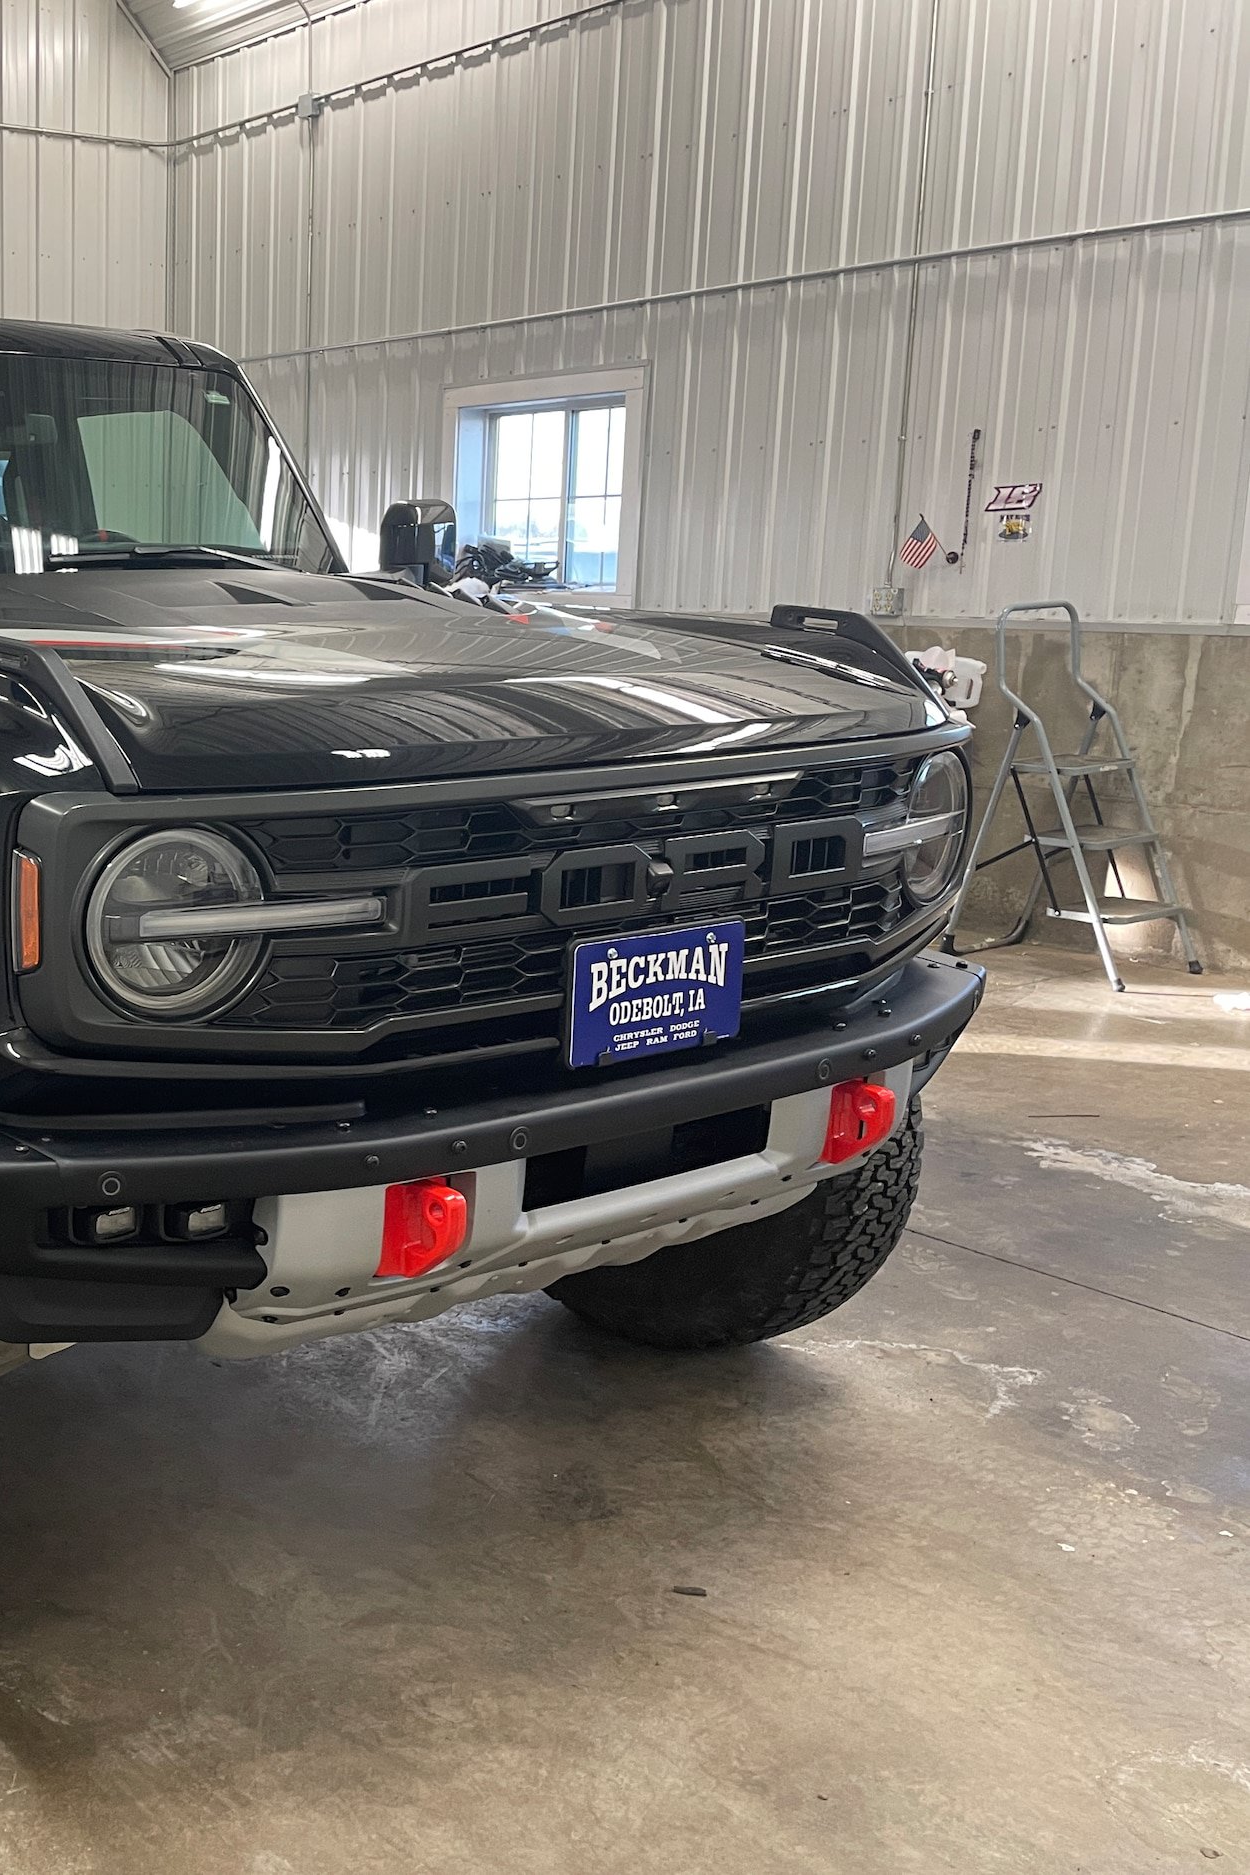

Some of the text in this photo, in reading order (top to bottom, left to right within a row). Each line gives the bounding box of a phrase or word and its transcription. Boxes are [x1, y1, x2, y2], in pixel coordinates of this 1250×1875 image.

[402, 815, 863, 944] FORD
[589, 942, 729, 1012] BECKMAN
[609, 987, 706, 1026] ODEBOLT, IA
[613, 1019, 701, 1043] CHRYSLER DODGE
[615, 1030, 698, 1052] JEEP RAM FORD
